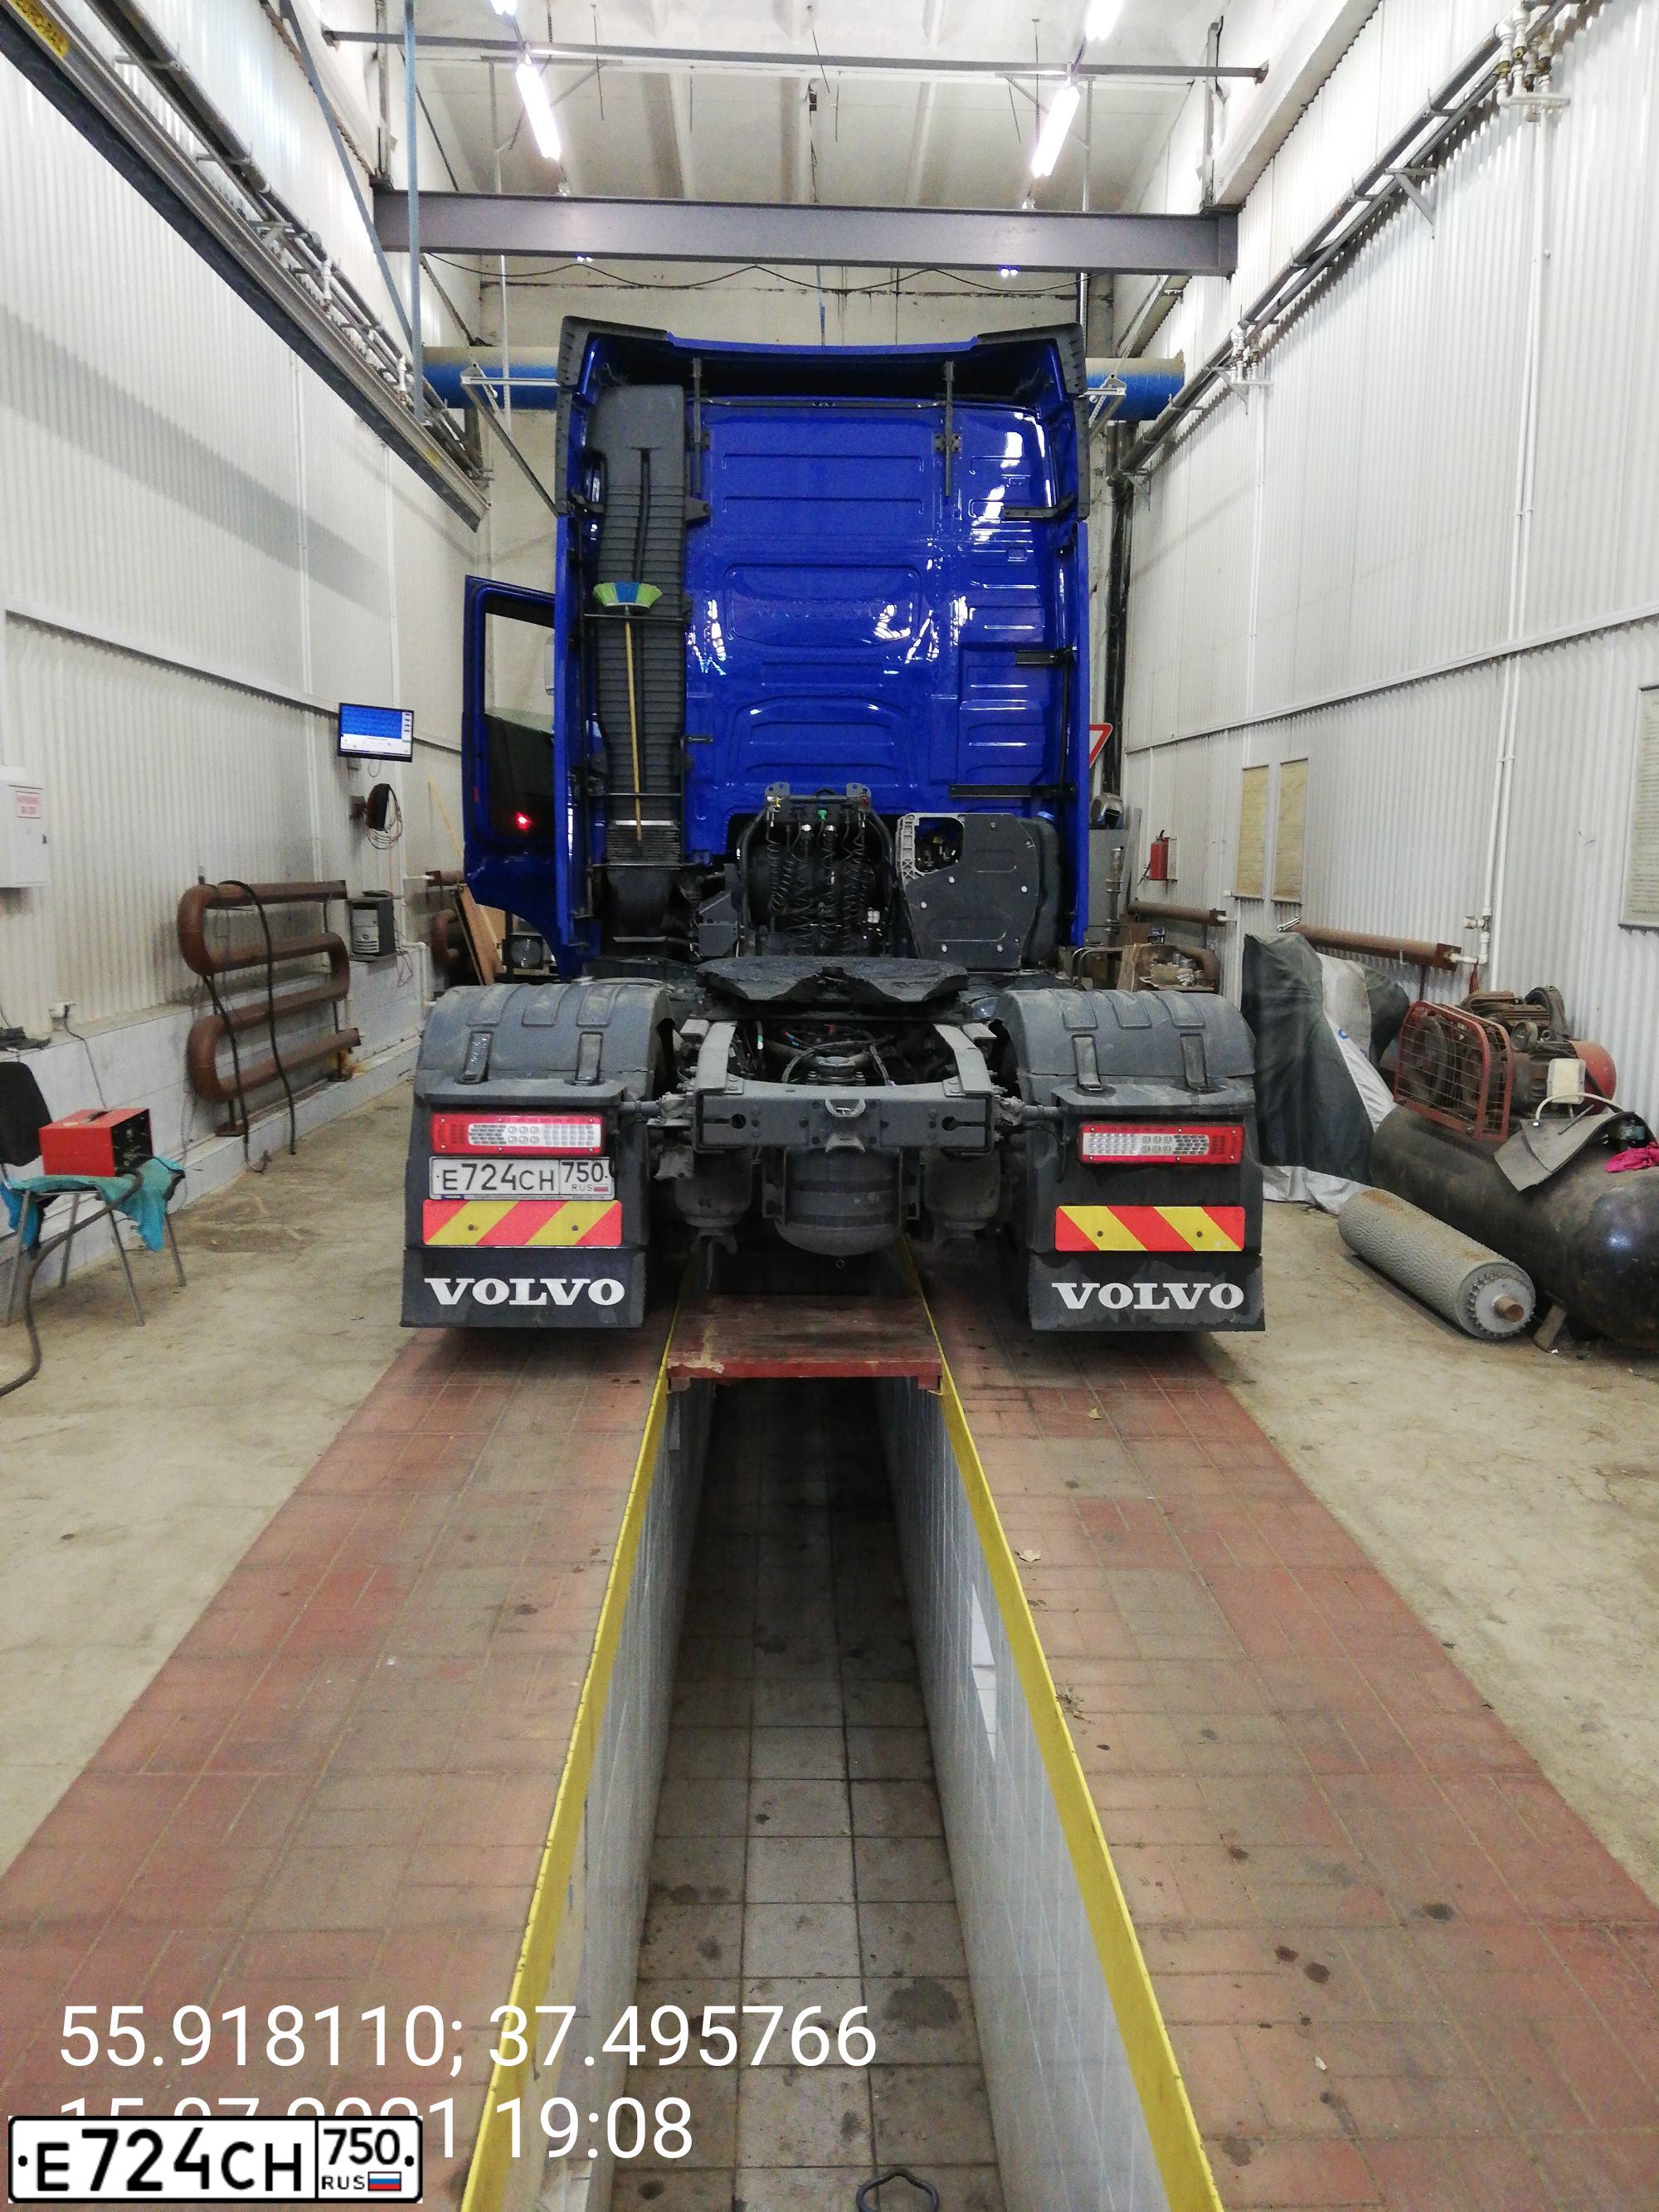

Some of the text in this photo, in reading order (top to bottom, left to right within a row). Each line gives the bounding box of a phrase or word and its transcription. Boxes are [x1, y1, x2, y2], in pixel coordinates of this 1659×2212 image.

[561, 1162, 605, 1183] 750
[424, 1278, 625, 1306] VOLVO
[1051, 1282, 1244, 1310] VOLVO
